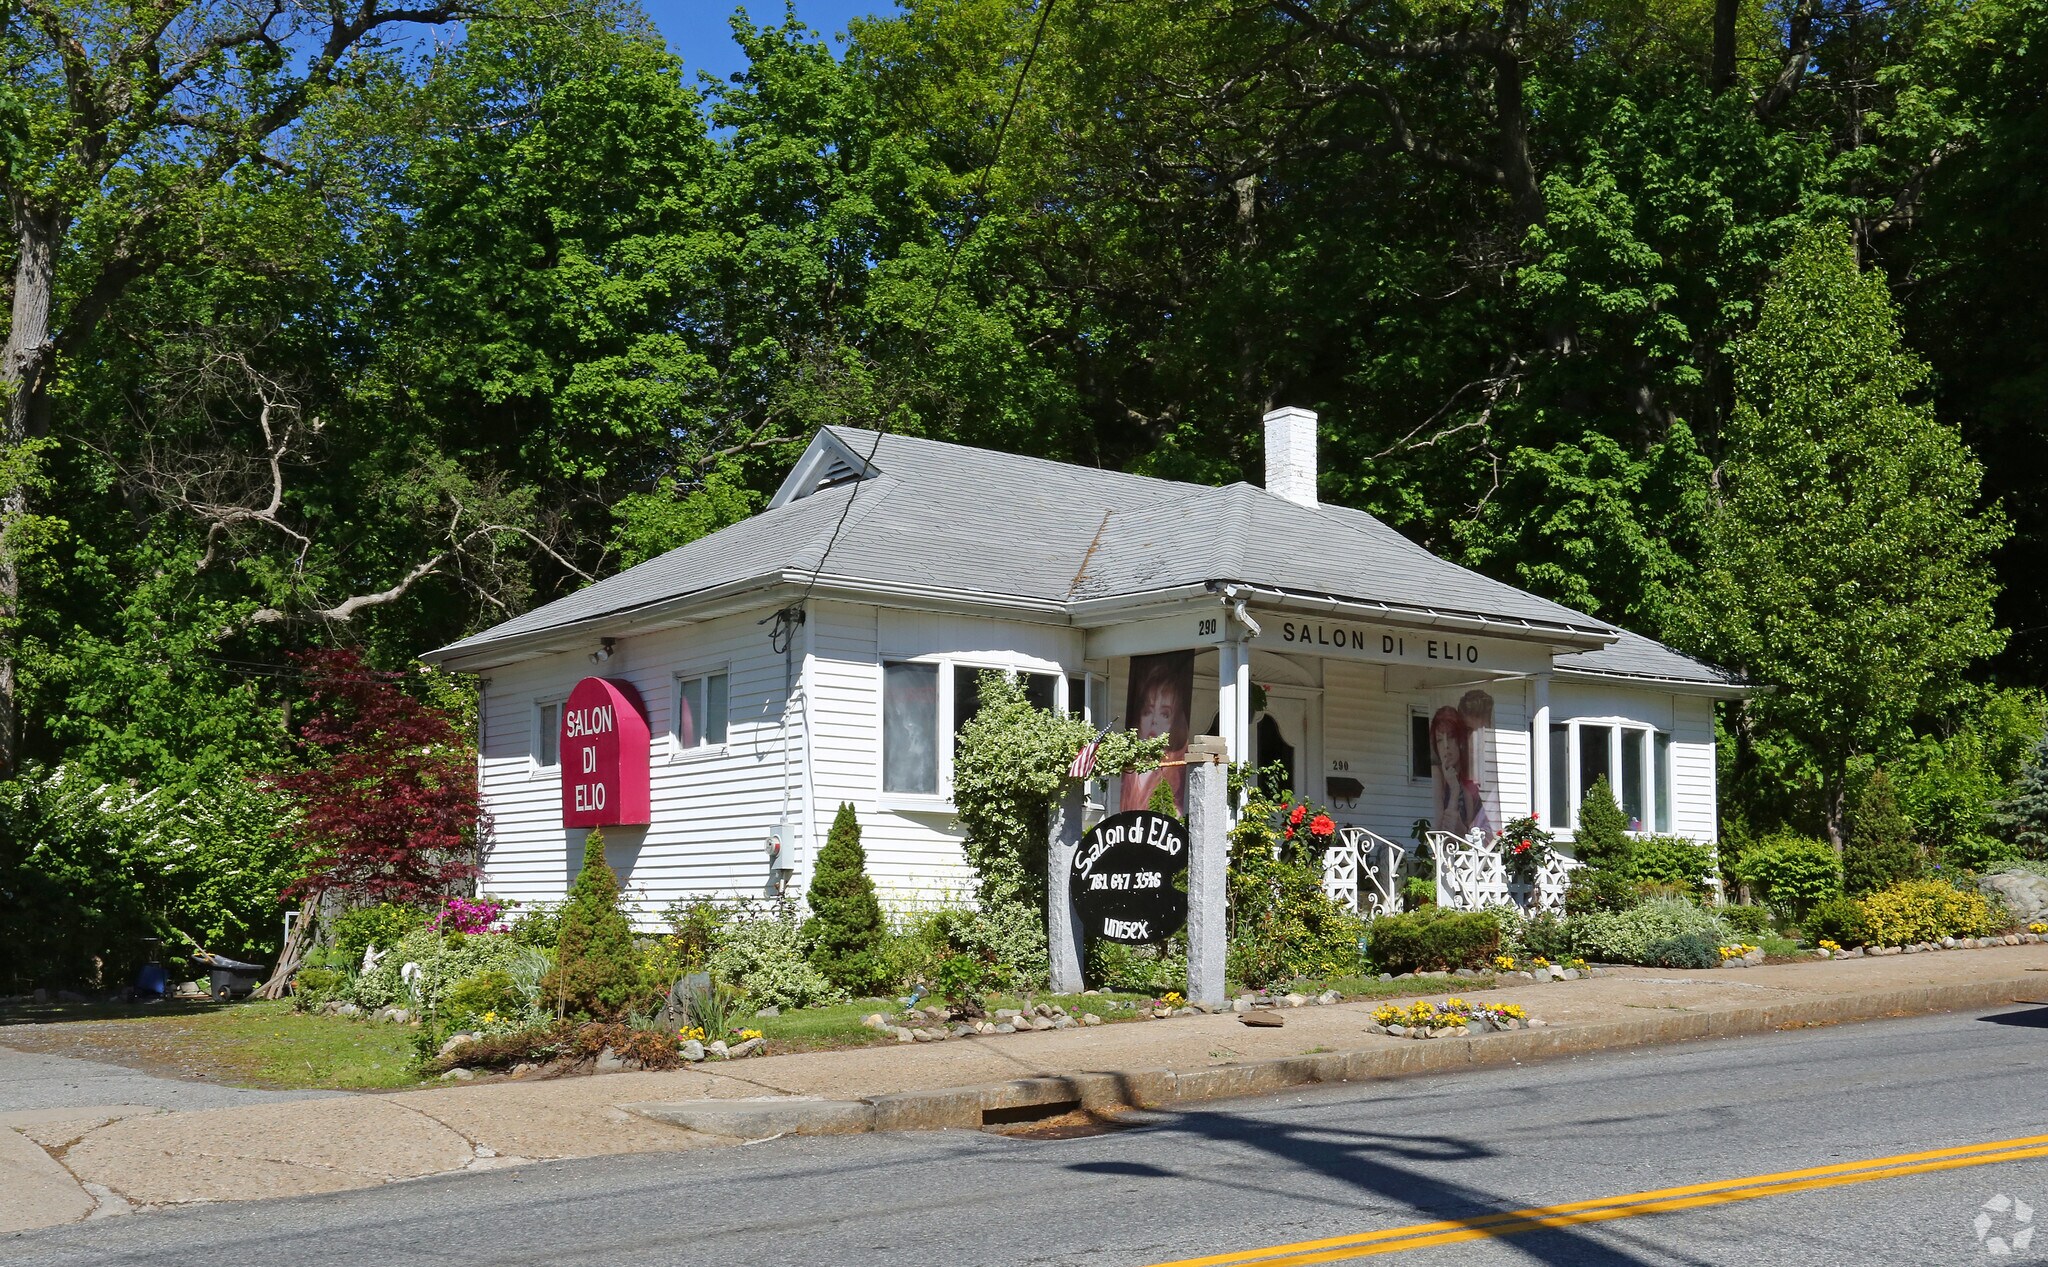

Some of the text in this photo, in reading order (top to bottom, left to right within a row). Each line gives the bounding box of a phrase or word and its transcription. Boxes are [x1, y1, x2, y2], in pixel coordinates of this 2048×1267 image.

[1199, 618, 1217, 636] 290
[1283, 622, 1479, 663] SALON DI ELIO
[566, 704, 613, 738] SALON
[582, 746, 597, 774] DI
[1332, 760, 1349, 771] 290
[575, 782, 606, 812] ELIO
[1089, 873, 1109, 890] 781
[1110, 873, 1131, 890] 647
